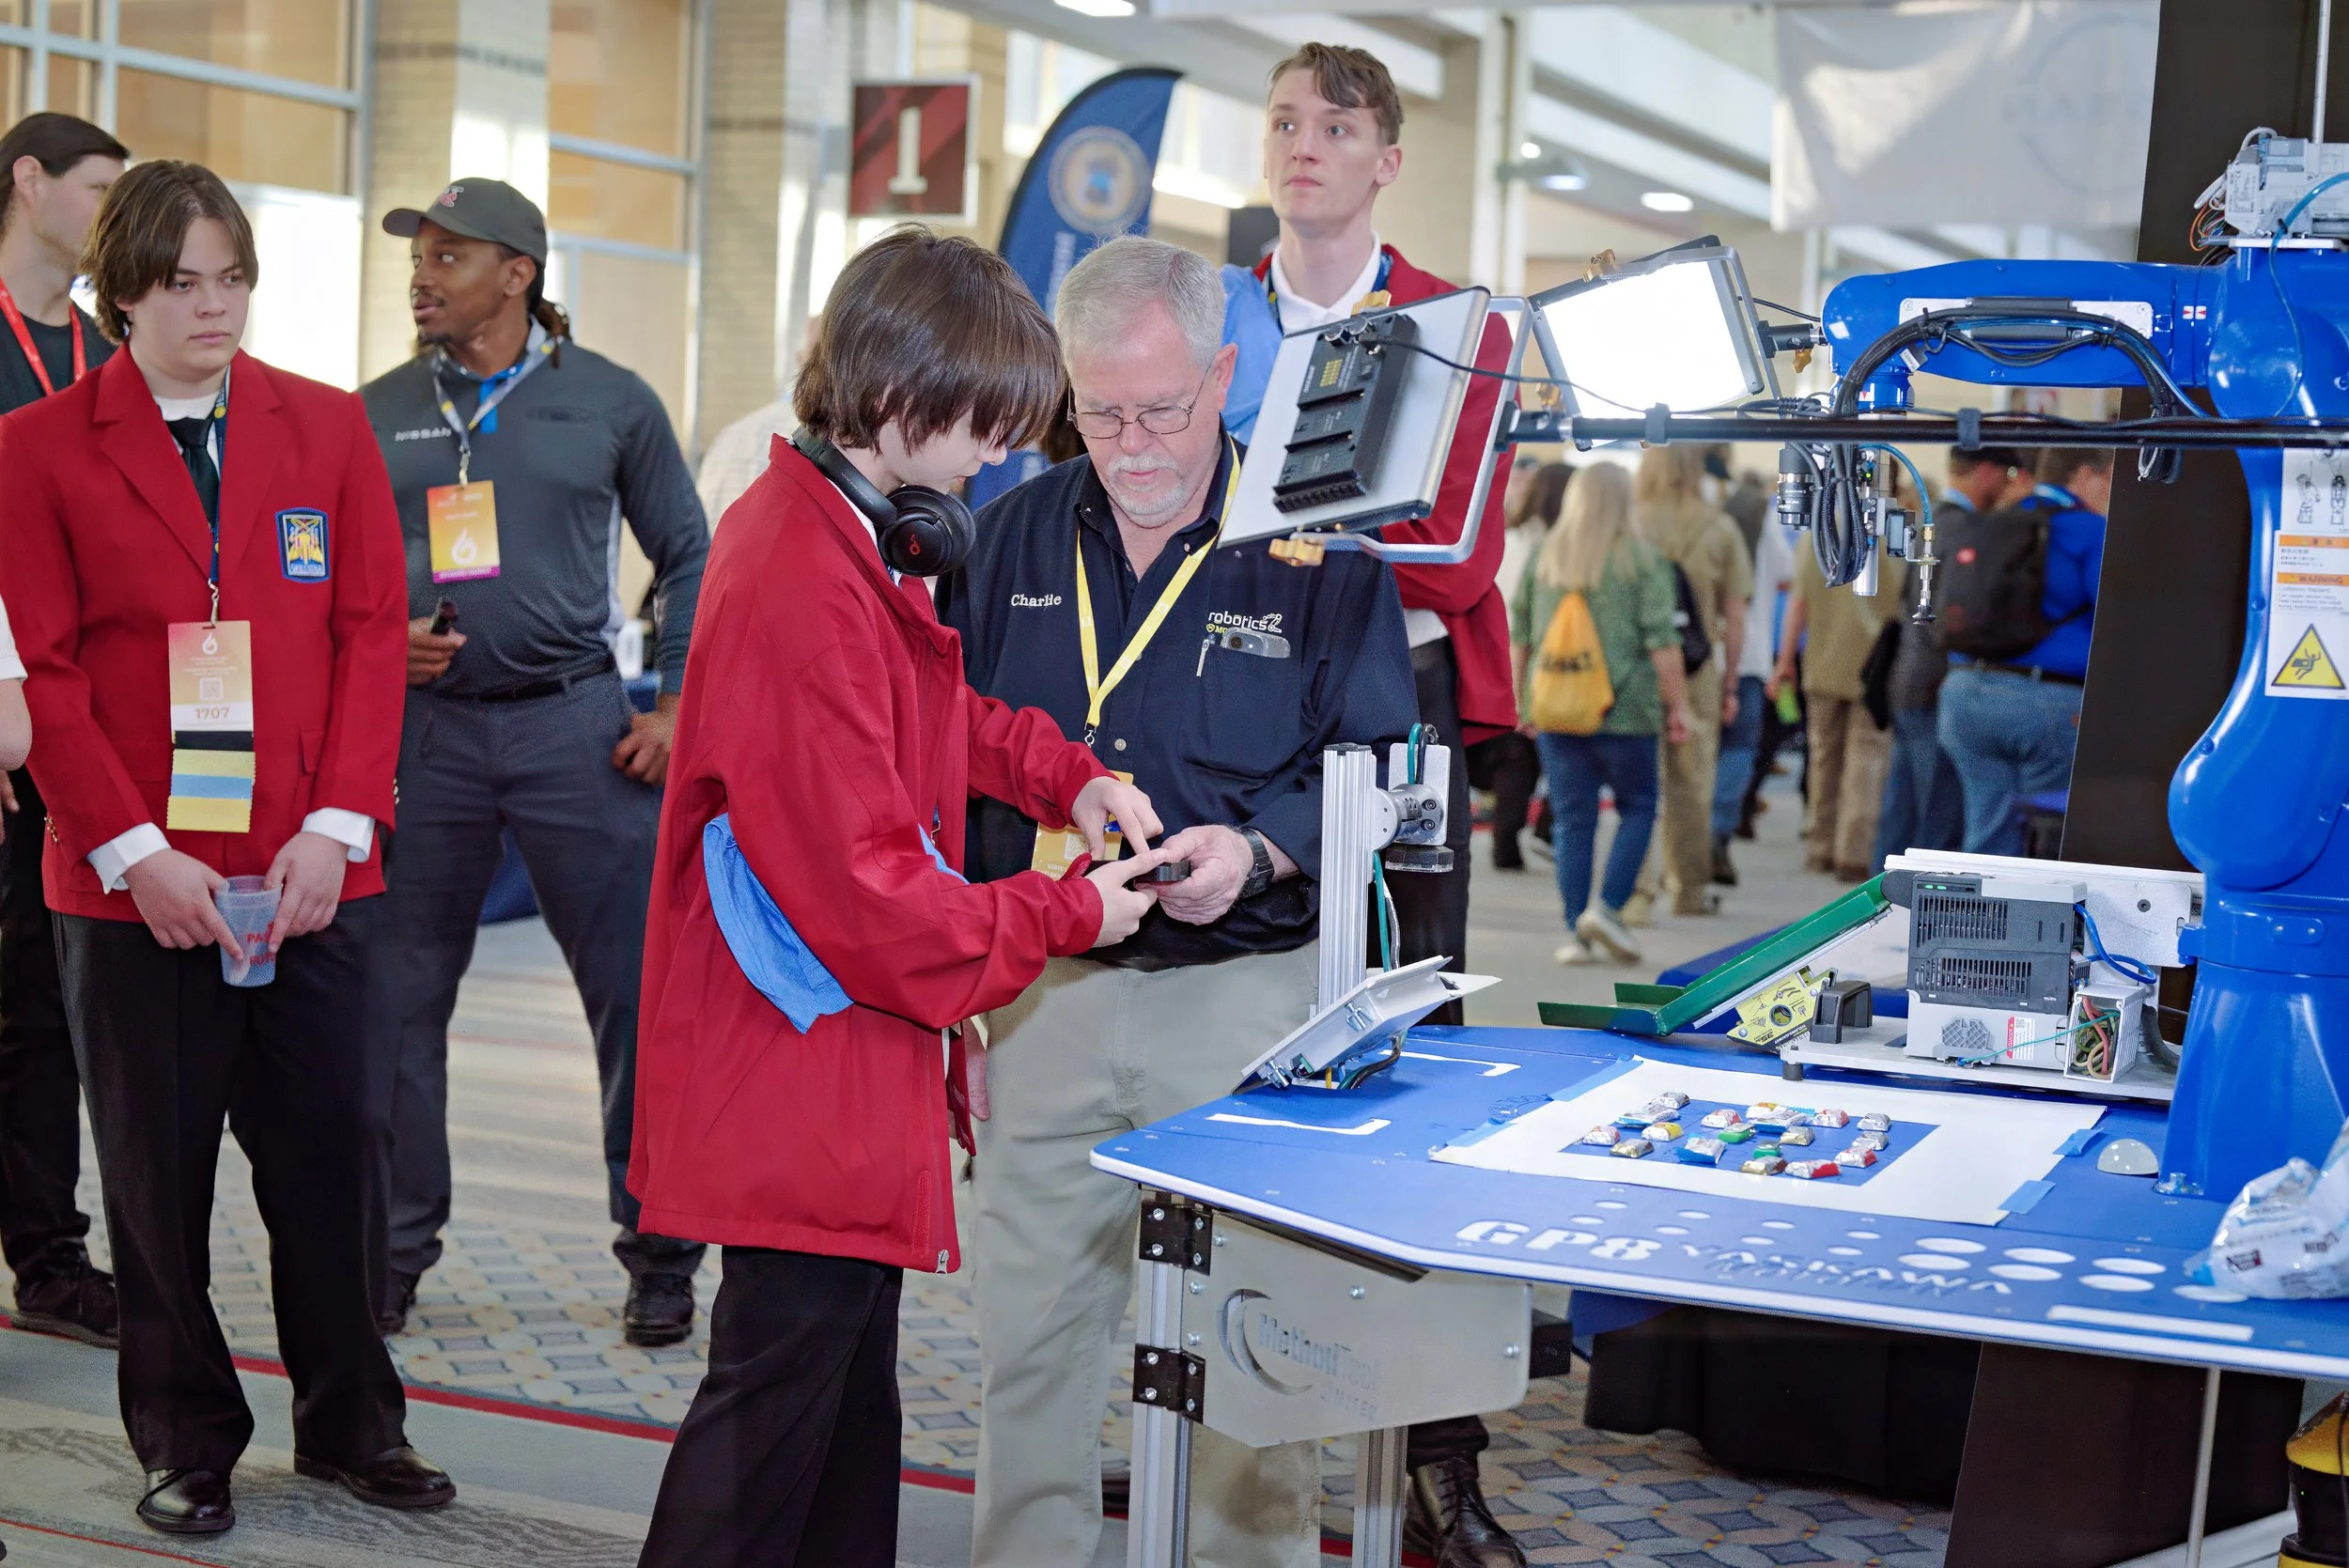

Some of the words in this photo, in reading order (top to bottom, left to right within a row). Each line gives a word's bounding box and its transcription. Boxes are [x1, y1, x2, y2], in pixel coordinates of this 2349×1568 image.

[888, 105, 928, 194] 1
[1010, 593, 1062, 607] Charlie
[194, 706, 230, 720] 1707
[1455, 1219, 1662, 1261] GP8
